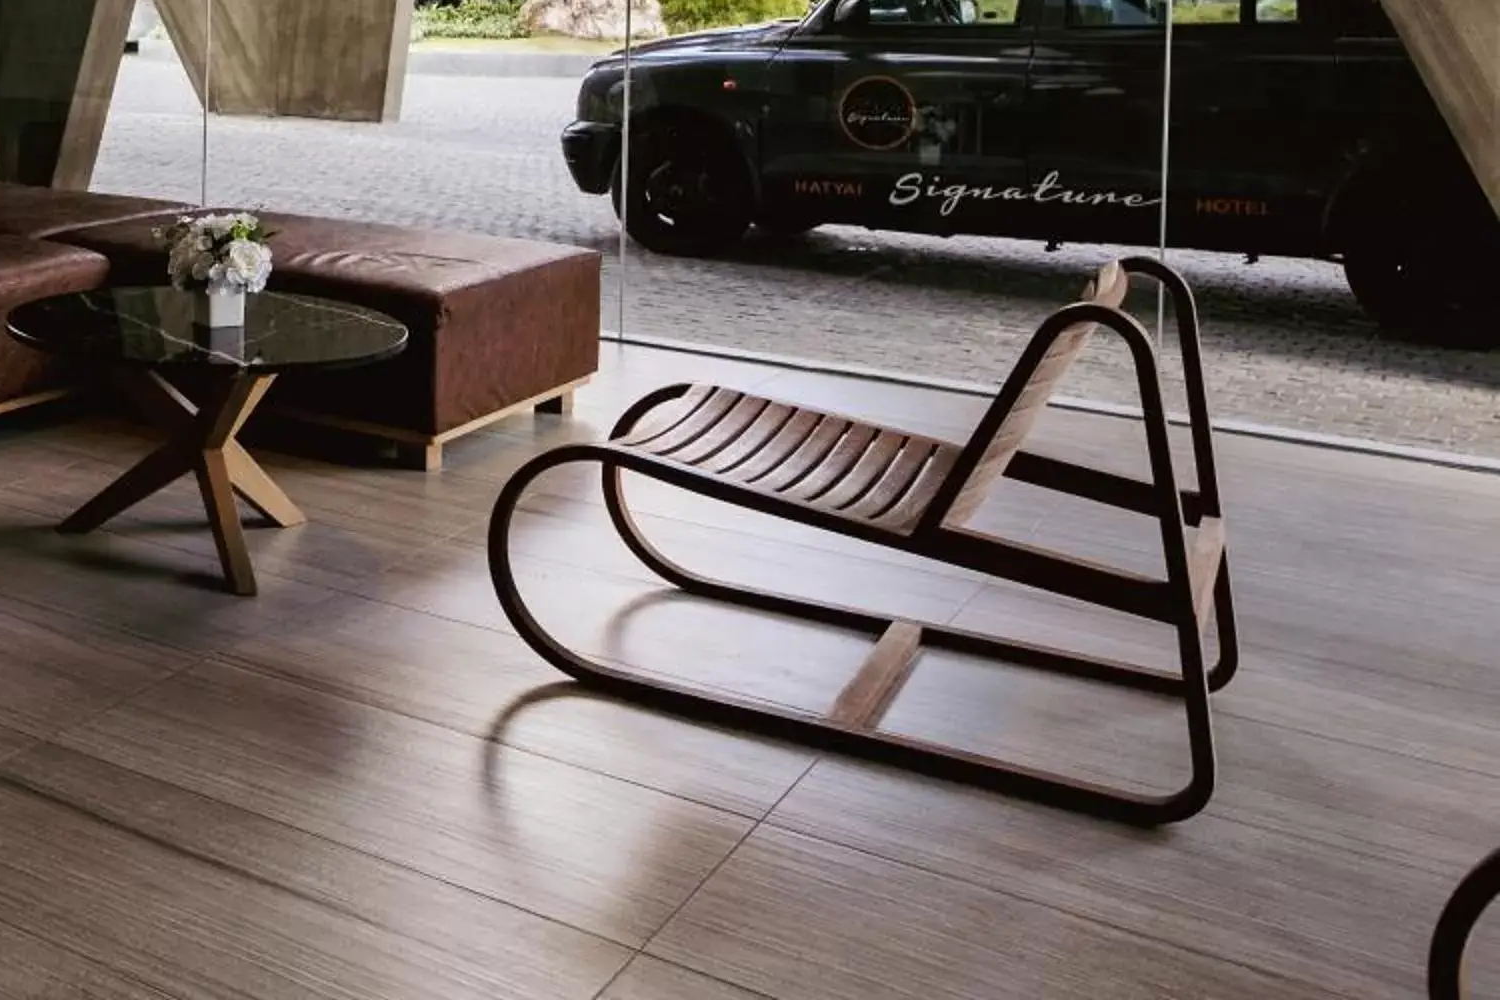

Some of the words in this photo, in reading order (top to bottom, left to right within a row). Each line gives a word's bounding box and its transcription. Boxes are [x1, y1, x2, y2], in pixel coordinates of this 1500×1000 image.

[794, 179, 863, 196] HATYAI
[888, 169, 1164, 217] Signature
[1196, 198, 1269, 216] HOTEL
